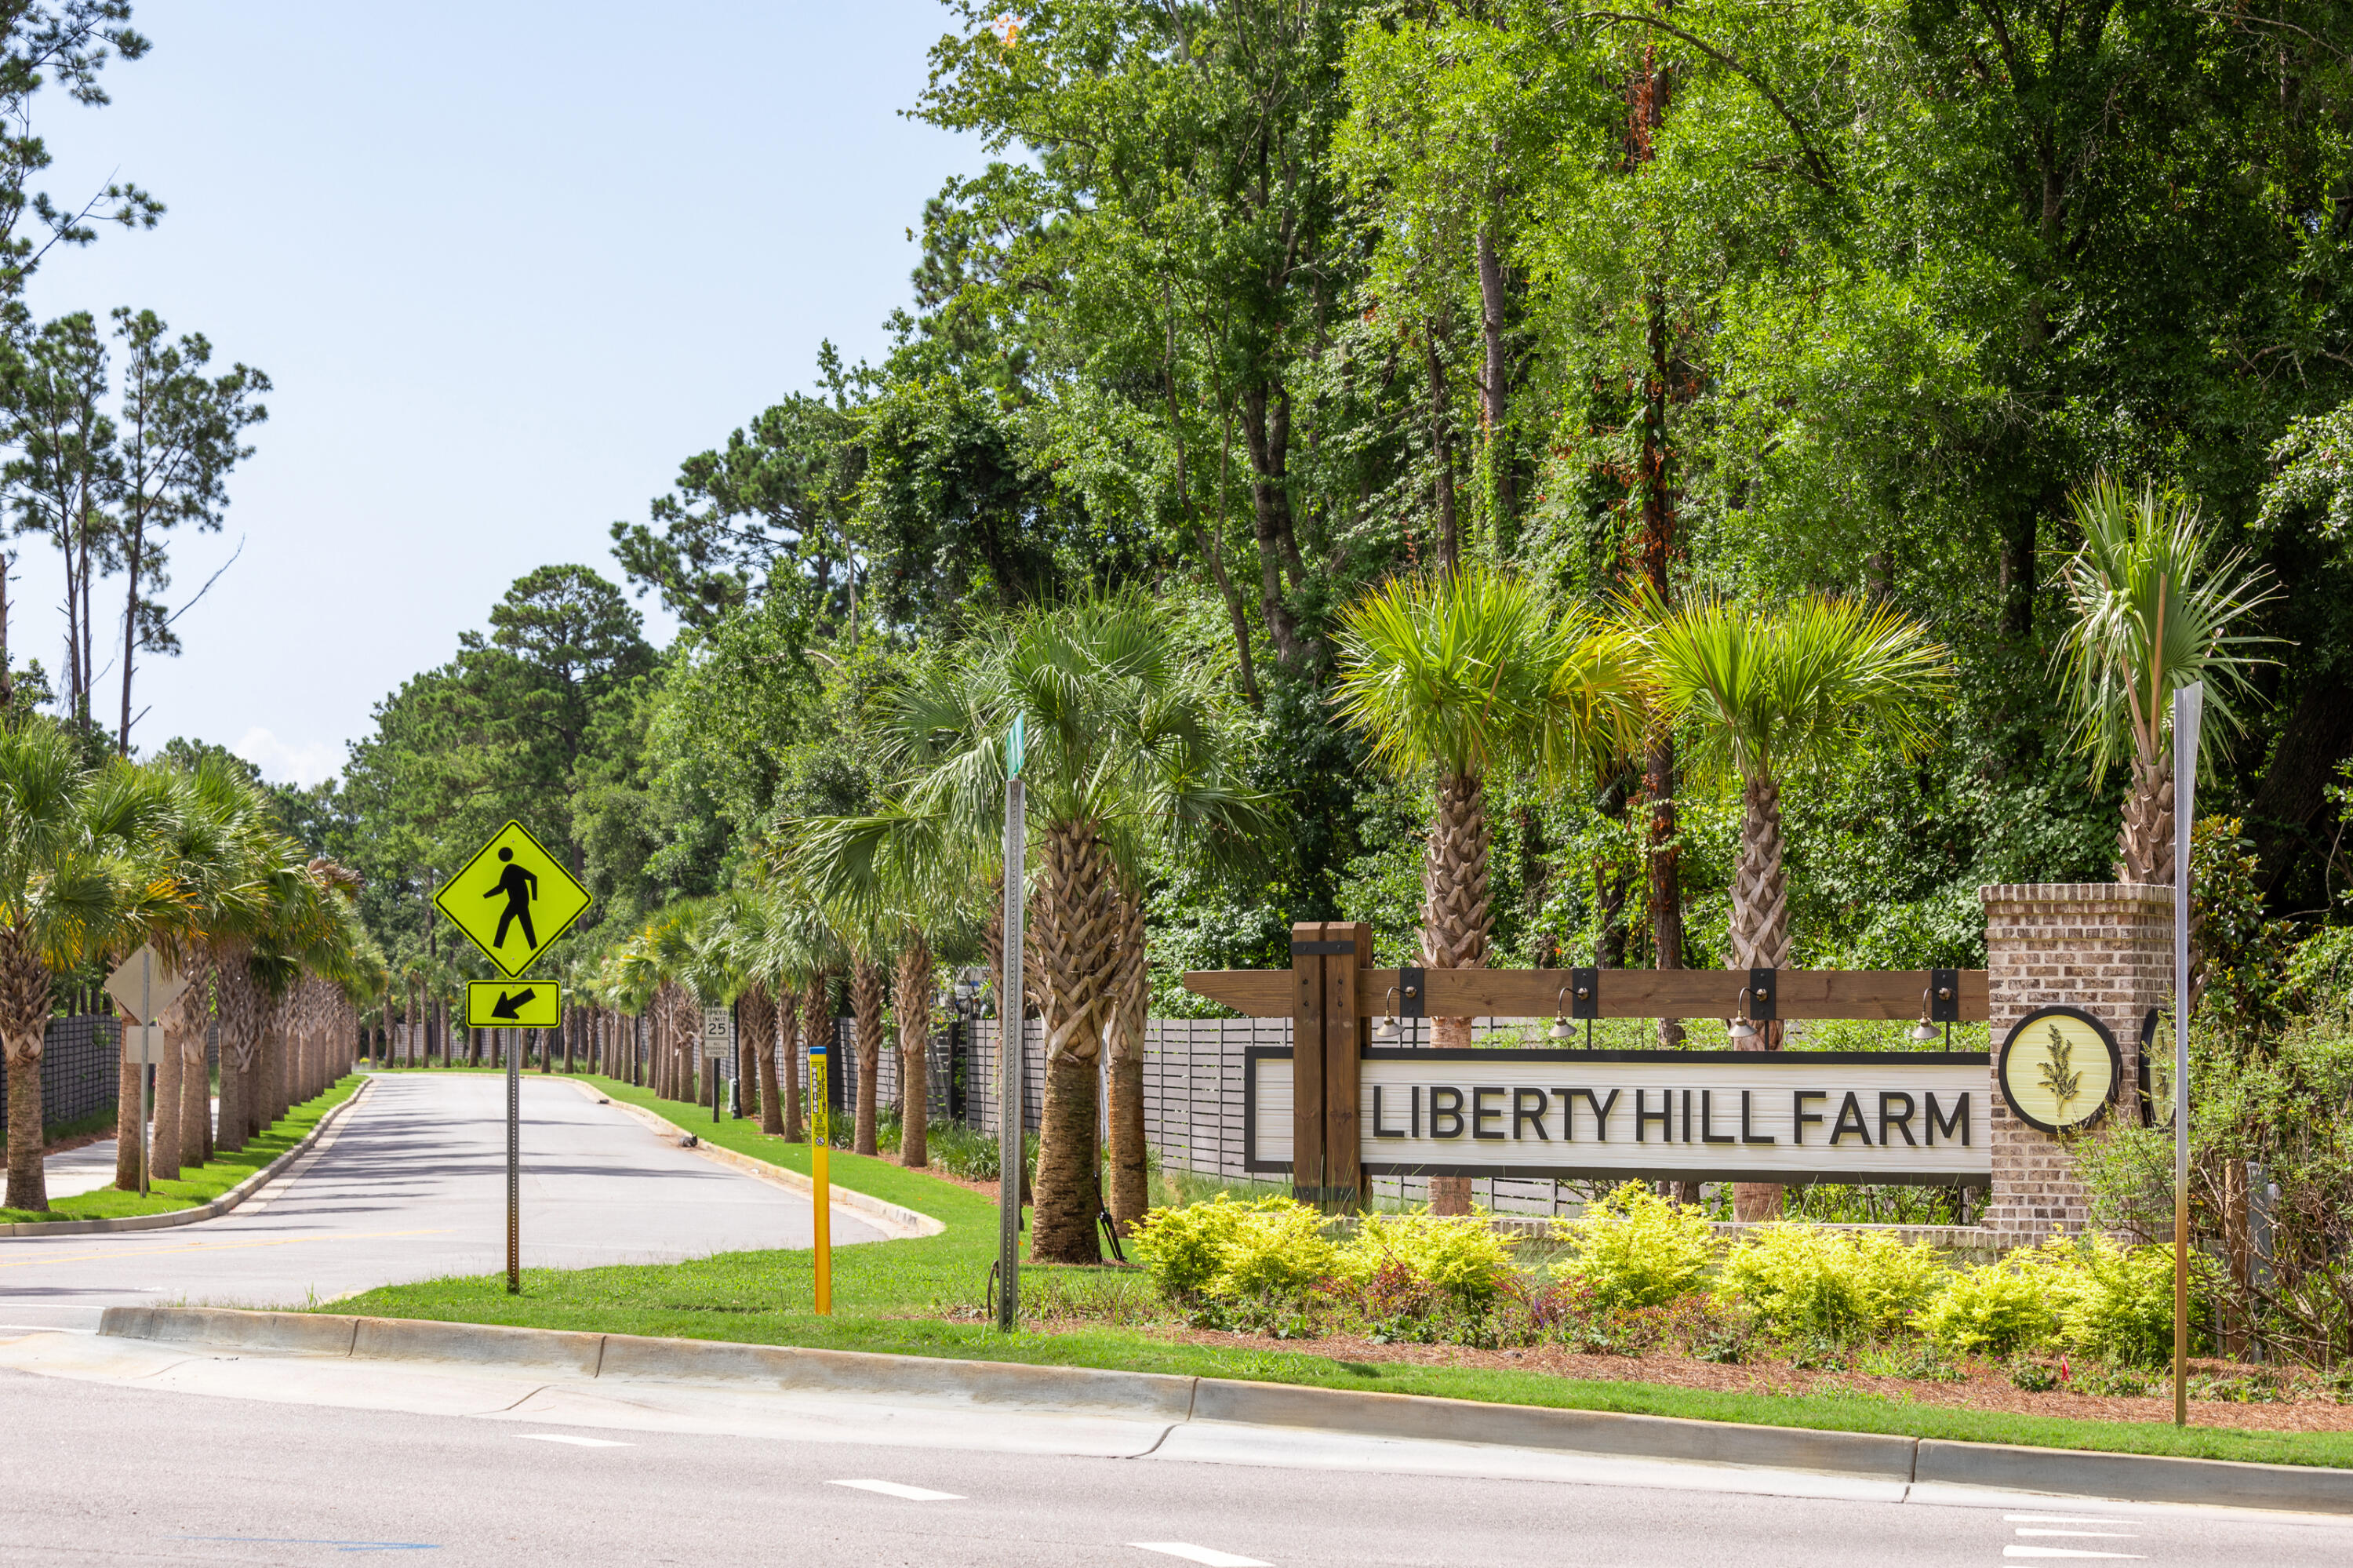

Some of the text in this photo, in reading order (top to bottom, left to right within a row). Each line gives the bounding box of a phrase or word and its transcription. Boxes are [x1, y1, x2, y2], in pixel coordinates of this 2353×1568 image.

[709, 1023, 726, 1035] 25
[1373, 1085, 1970, 1147] LIBERTY HILL FARM
